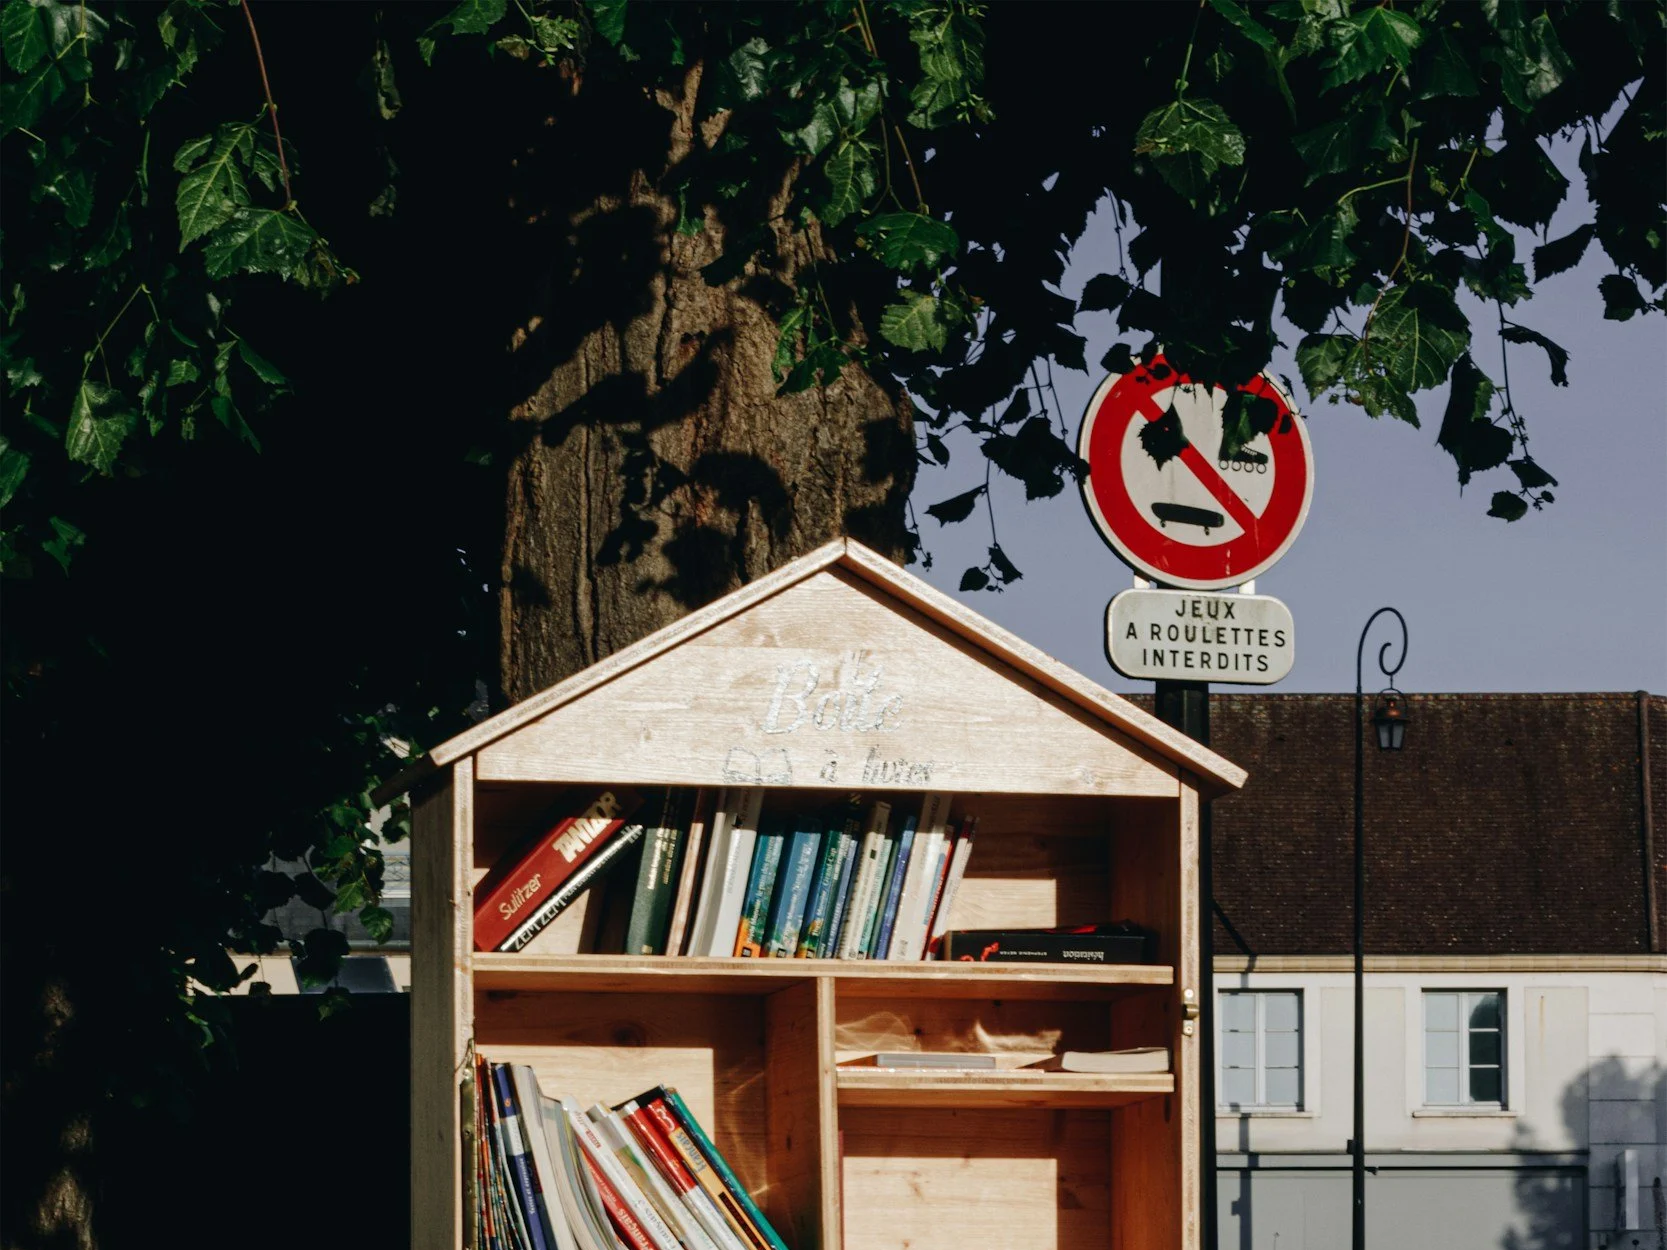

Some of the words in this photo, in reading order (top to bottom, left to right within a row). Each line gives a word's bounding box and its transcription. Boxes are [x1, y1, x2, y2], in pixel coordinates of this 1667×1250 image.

[1175, 600, 1235, 619] JEUX
[1126, 622, 1138, 640] A
[1150, 623, 1286, 648] ROULETTES
[1142, 648, 1269, 672] INTERDITS
[500, 872, 542, 920] Sulitzer
[515, 922, 542, 950] ZEM
[541, 898, 567, 925] ZEM
